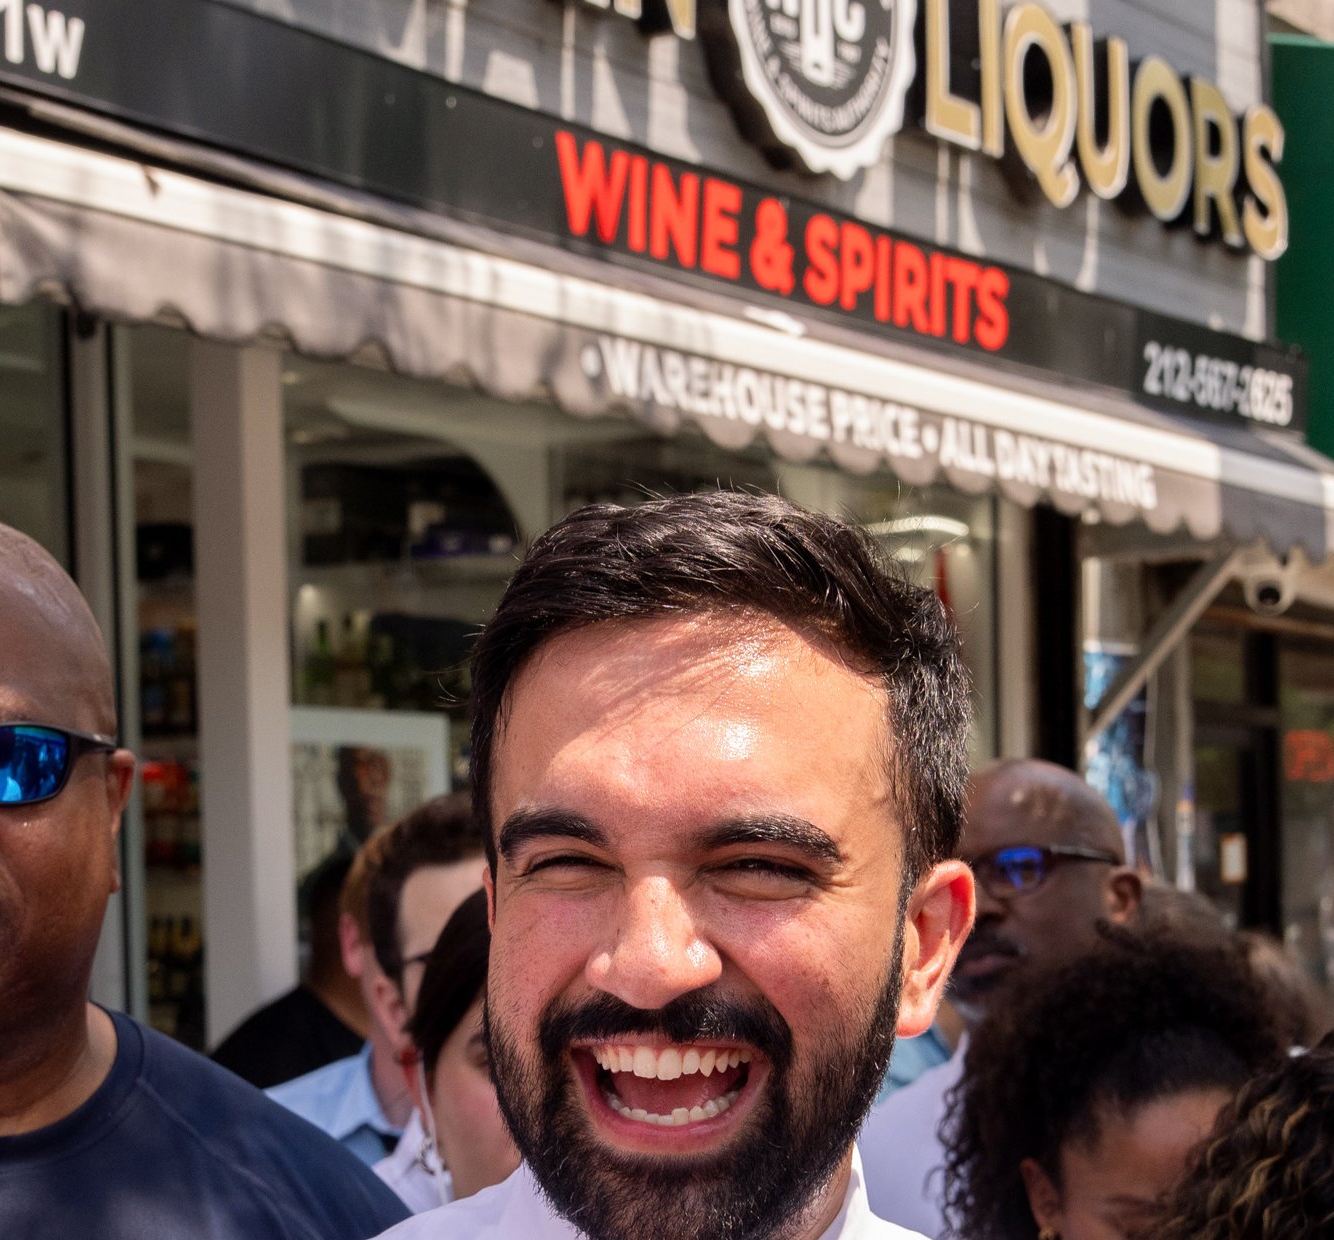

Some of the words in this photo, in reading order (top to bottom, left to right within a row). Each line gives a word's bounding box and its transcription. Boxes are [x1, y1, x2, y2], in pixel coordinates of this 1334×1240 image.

[555, 130, 741, 281] WINE
[750, 198, 795, 296] &
[803, 213, 1009, 351] SPIRITS
[925, 0, 1288, 260] LIQUORS
[598, 334, 831, 440] WAREHOUSE
[830, 388, 923, 460] PRICE
[938, 417, 995, 476] ALL
[995, 428, 1051, 488] DAY
[1047, 440, 1158, 511] TASTING
